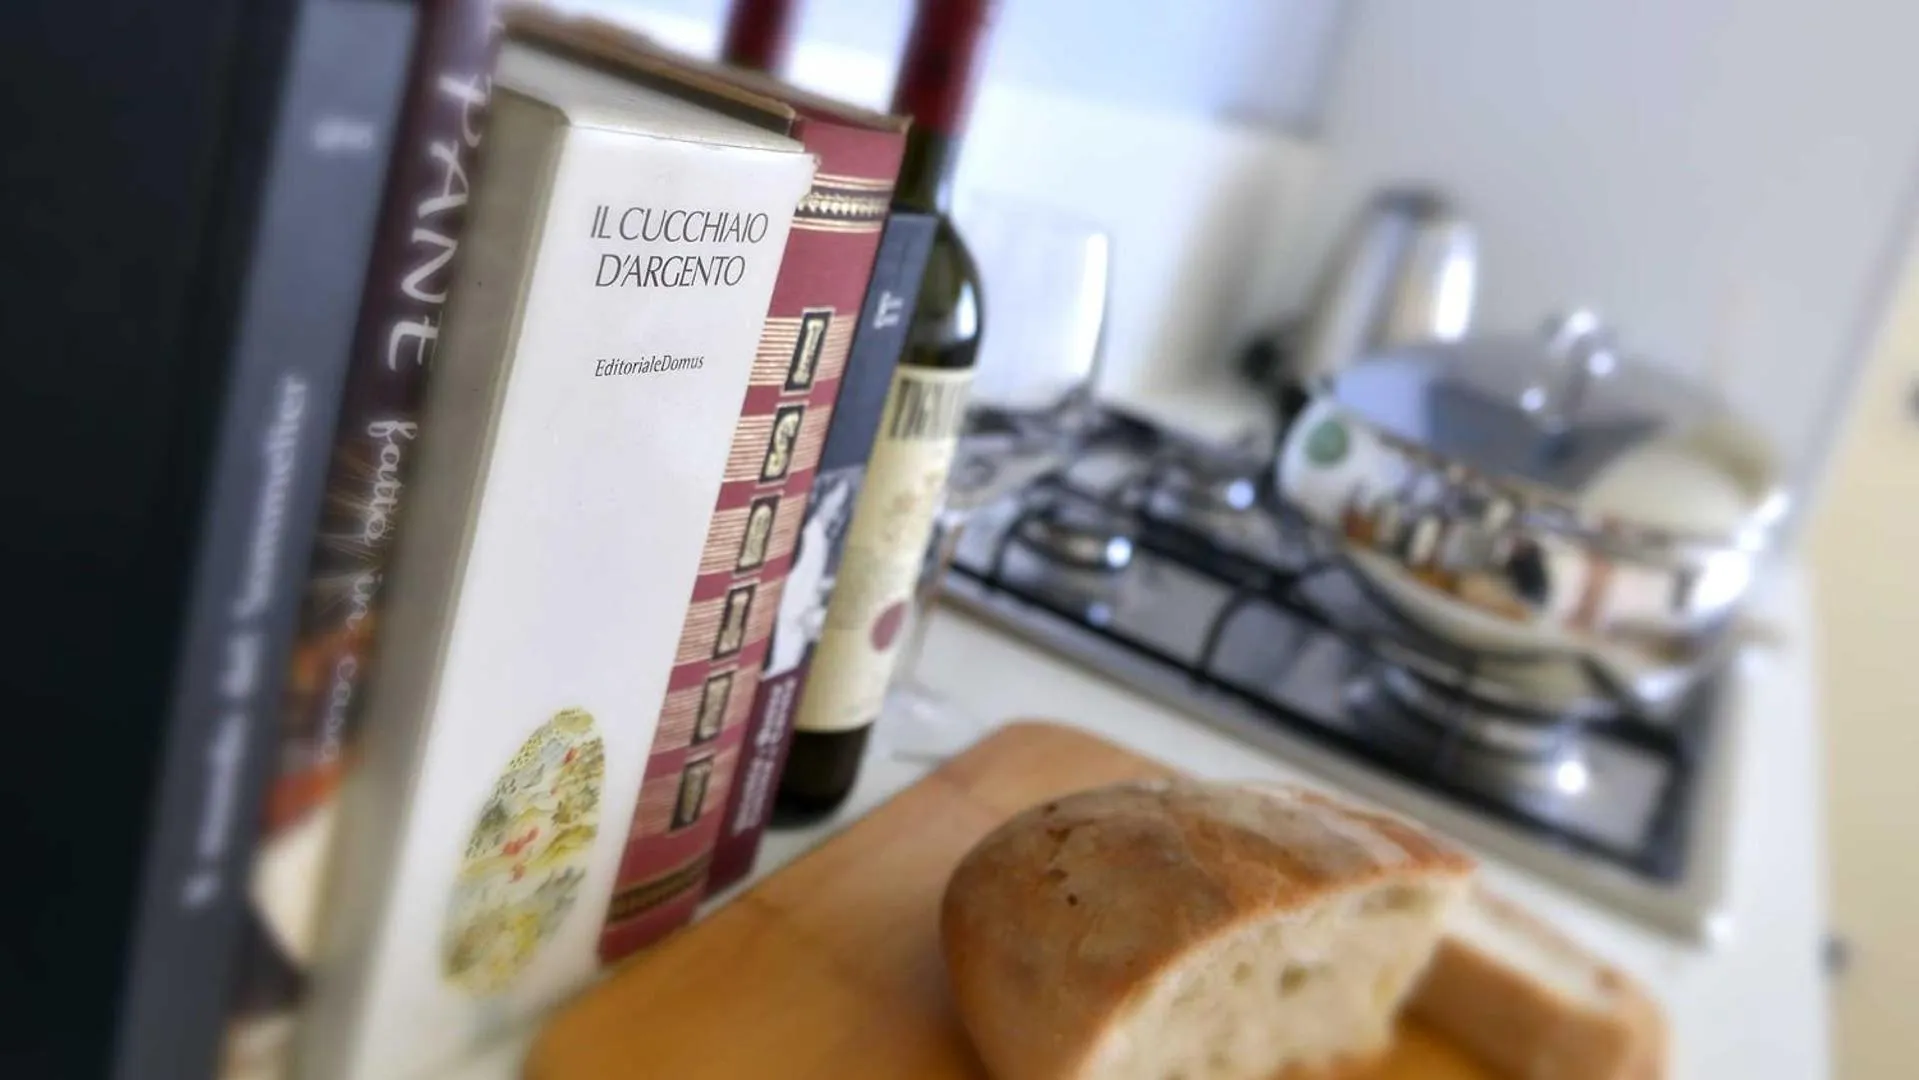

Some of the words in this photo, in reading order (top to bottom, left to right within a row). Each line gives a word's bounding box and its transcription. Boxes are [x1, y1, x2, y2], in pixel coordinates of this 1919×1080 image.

[590, 205, 611, 238] IL
[619, 206, 769, 244] CUCCHIAIO
[595, 254, 746, 288] D'ARGENTO
[595, 354, 704, 378] EditorialeDomus
